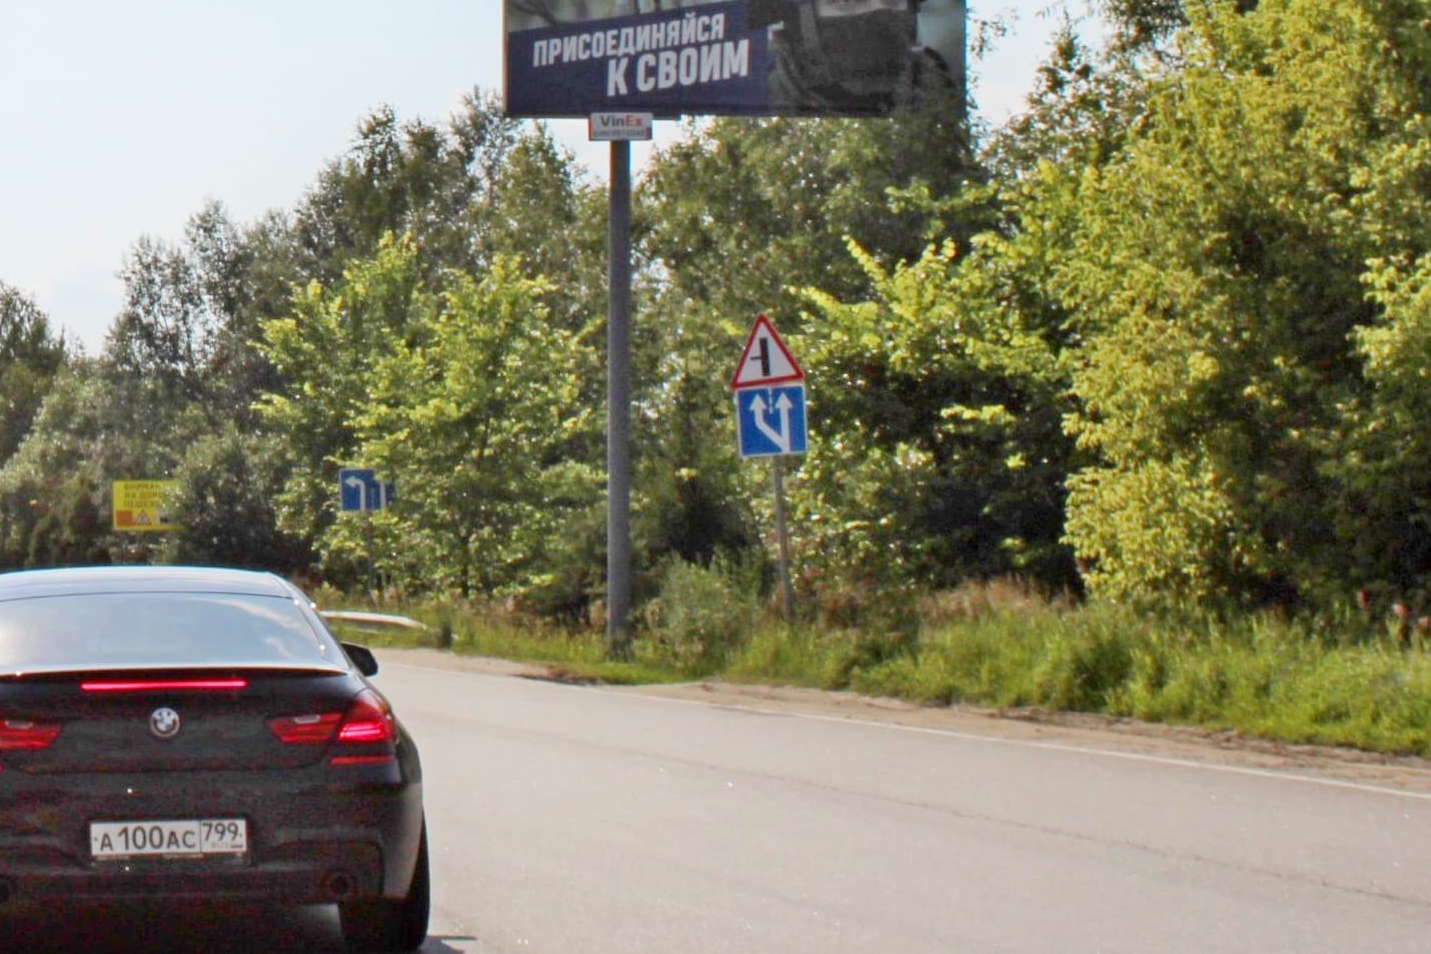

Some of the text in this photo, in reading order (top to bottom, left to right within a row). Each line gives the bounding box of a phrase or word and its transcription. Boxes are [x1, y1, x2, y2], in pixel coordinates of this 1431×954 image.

[533, 12, 726, 68] ПРИСОЕДИНЯЙСЯ
[607, 39, 751, 97] К СВОИМ
